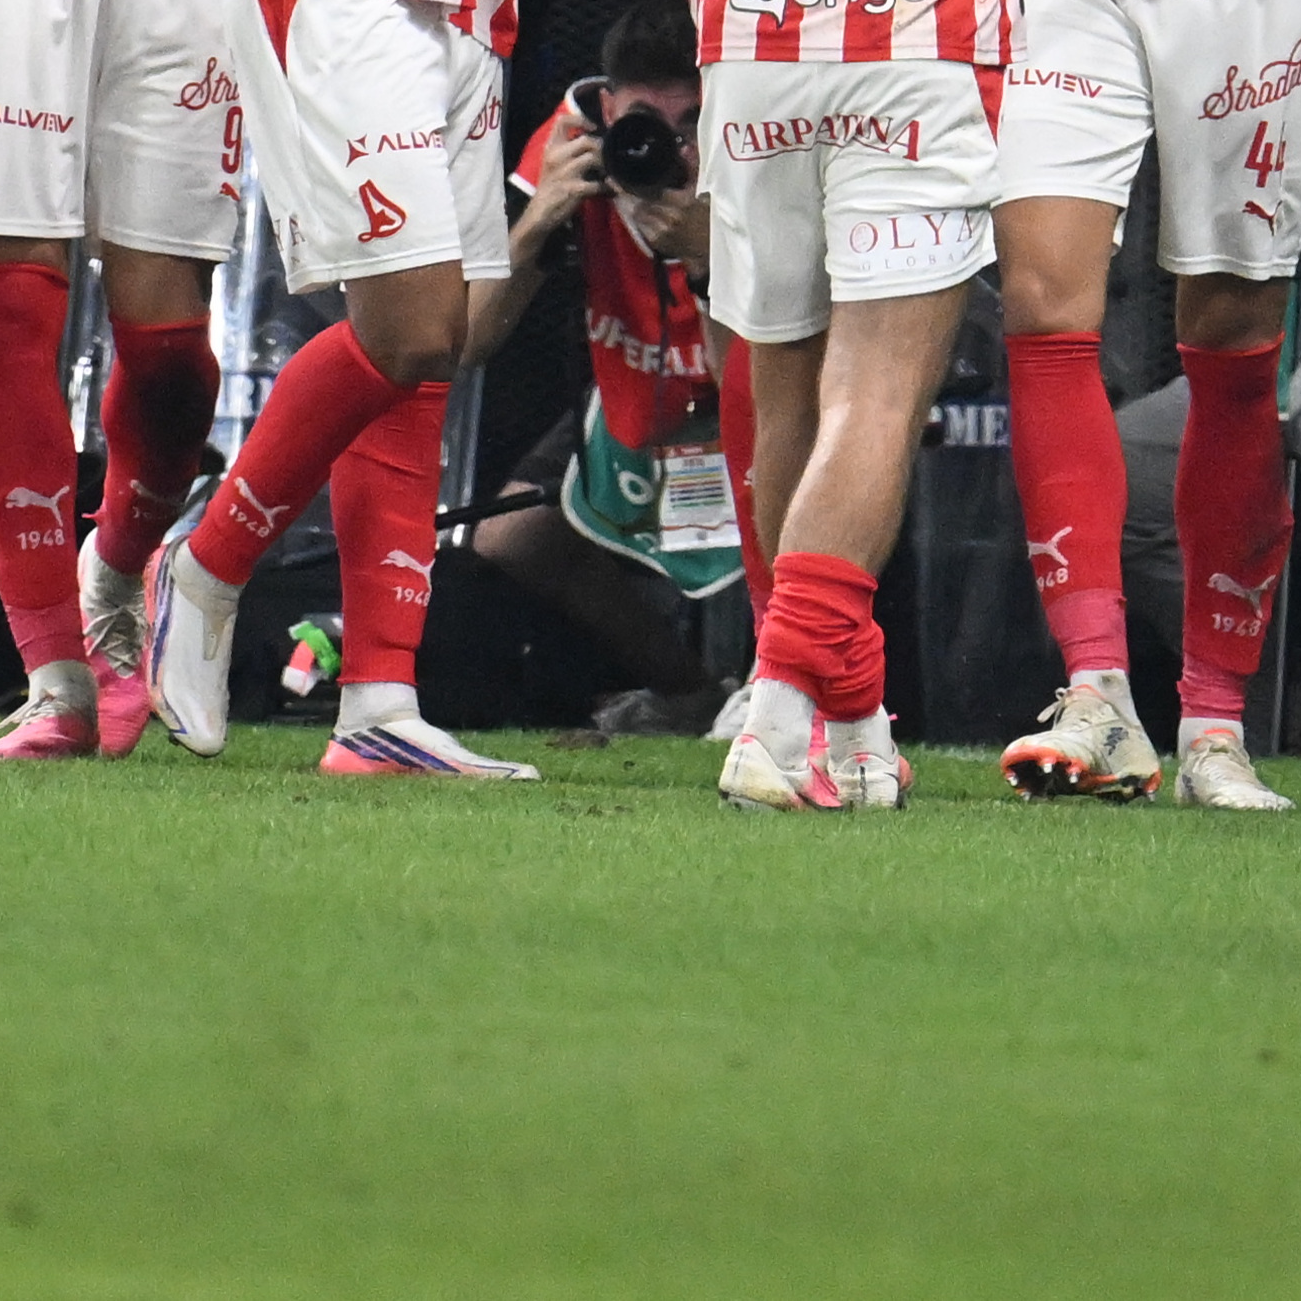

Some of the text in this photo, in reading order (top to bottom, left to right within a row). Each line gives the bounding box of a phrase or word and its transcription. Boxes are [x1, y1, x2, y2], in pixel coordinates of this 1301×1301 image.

[1007, 68, 1104, 99] LLVIEW
[220, 106, 244, 174] 9
[722, 112, 922, 163] CARPATINA
[848, 208, 974, 255] OLYA
[16, 528, 66, 551] 1948
[1035, 566, 1070, 593] 948
[1211, 612, 1262, 638] 1948
